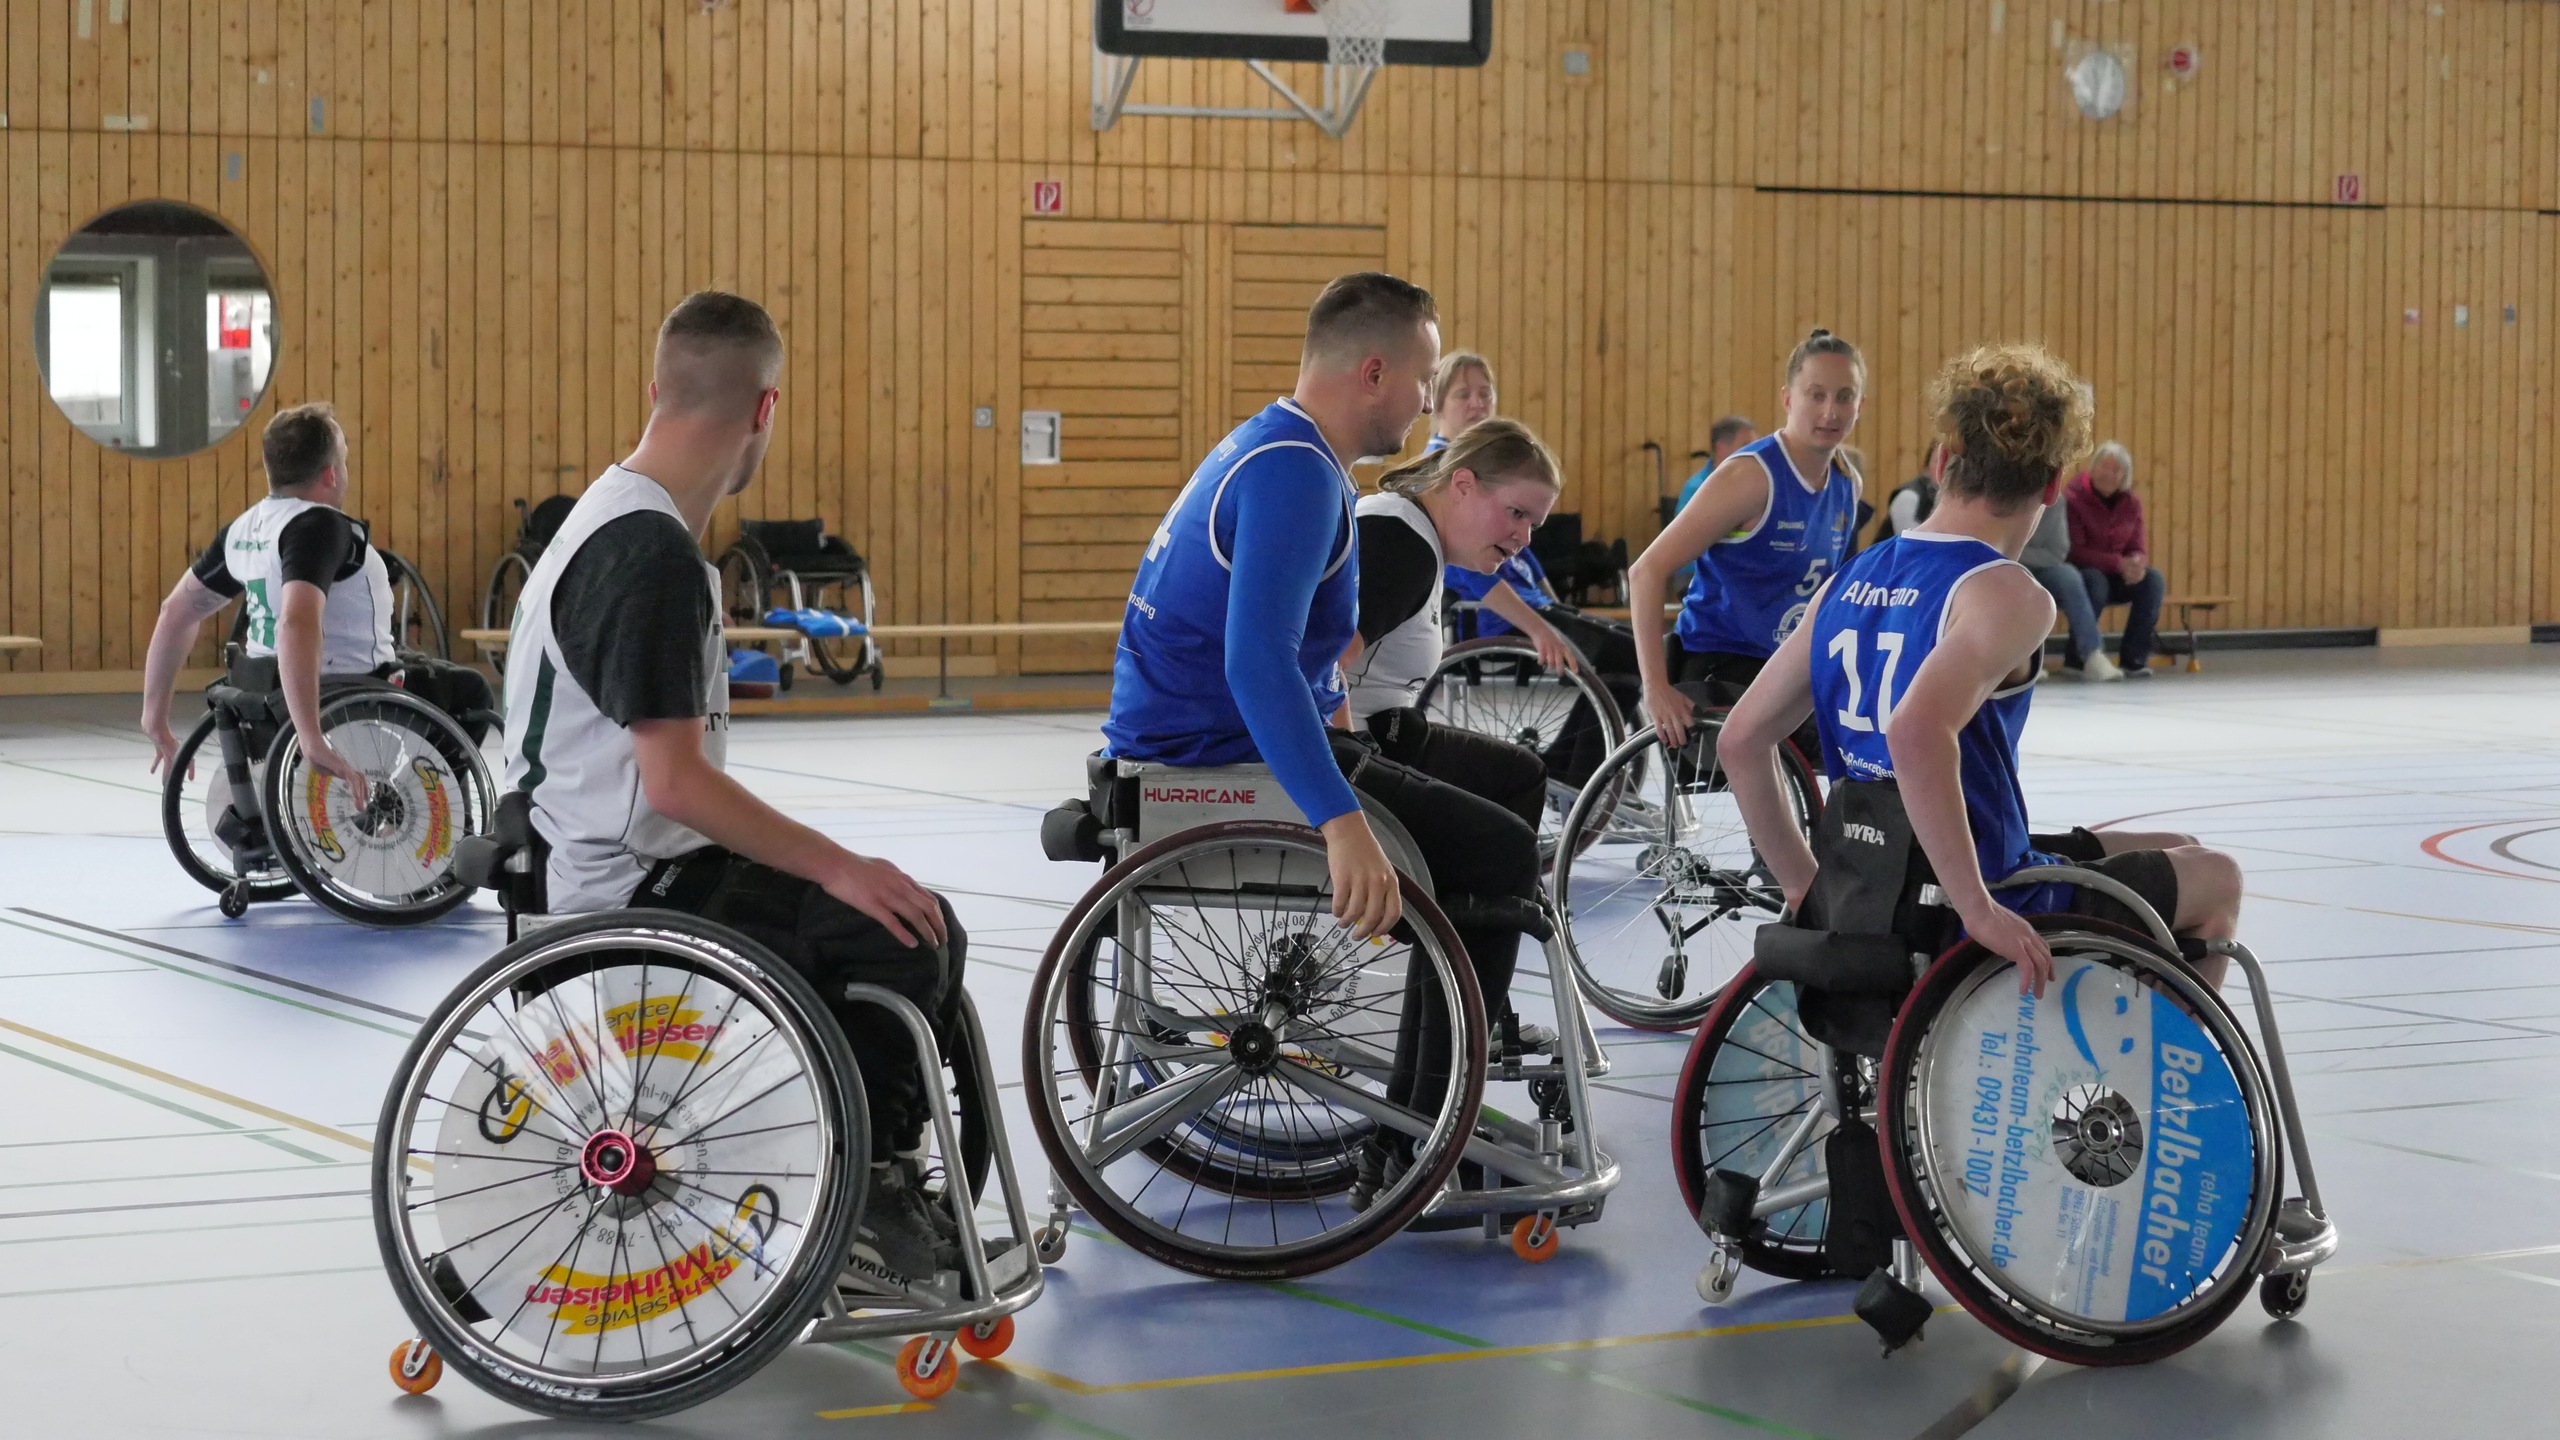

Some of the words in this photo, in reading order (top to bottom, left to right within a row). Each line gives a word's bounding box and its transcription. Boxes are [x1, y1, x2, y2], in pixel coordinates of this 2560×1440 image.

[1795, 558, 1828, 598] 5
[1828, 628, 1905, 734] 17
[1144, 788, 1255, 804] HURRICANE
[1964, 1077, 2001, 1197] 09431-1007
[1991, 988, 2037, 1269] ww.rehateam-betzlbacher.de
[2139, 1042, 2203, 1286] Betzlbacher
[2196, 1171, 2220, 1214] reha
[2188, 1219, 2214, 1267] team
[525, 1244, 713, 1310] Mühleisen
